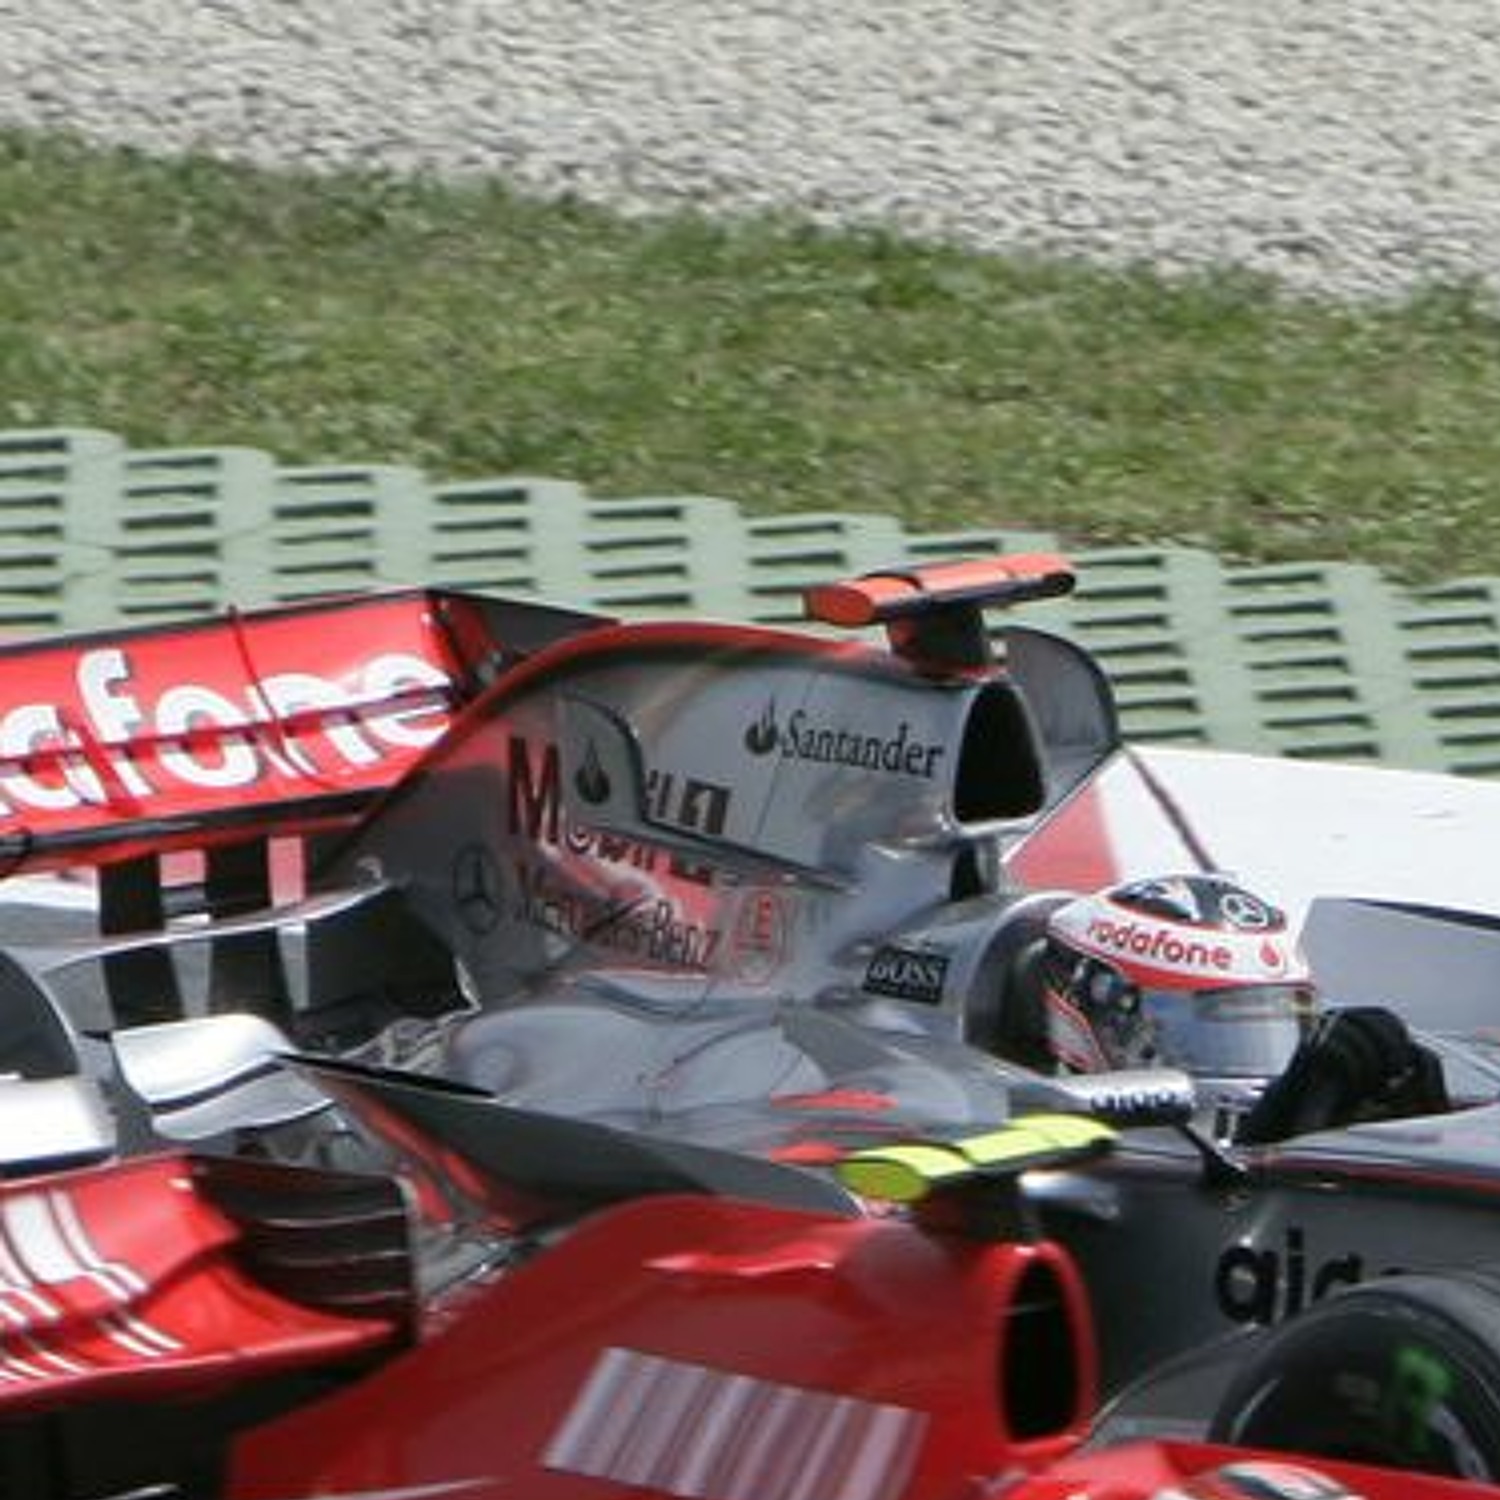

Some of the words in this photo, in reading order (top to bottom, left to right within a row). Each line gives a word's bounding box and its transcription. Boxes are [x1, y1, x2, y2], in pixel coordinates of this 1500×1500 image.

[0, 648, 452, 816] afone
[782, 709, 945, 778] Santander
[1215, 1226, 1408, 1328] ai
